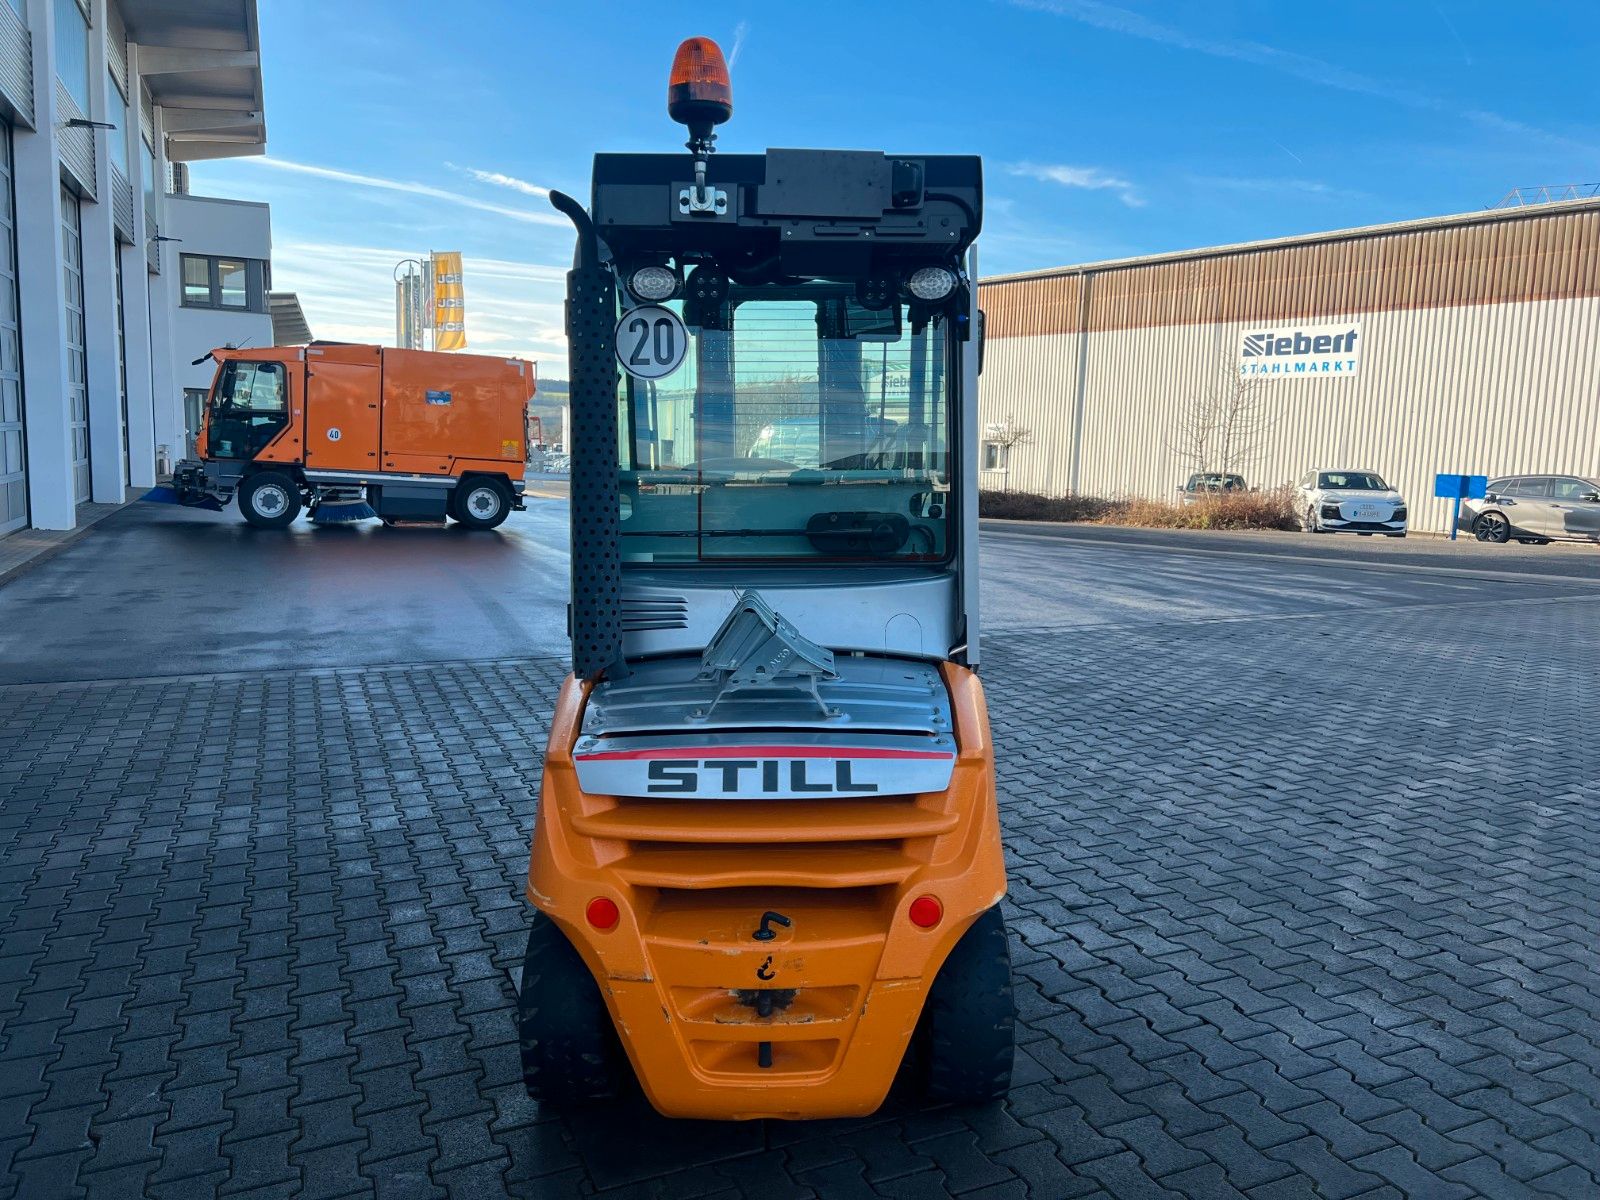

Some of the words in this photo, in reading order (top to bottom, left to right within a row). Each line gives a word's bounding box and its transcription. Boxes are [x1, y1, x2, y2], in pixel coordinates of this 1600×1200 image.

[437, 273, 463, 284] JCB
[437, 298, 464, 308] JCB
[437, 322, 464, 332] JCB
[629, 318, 675, 366] 20
[1242, 329, 1358, 357] Siebert
[1241, 361, 1356, 375] STAHLMARKT
[329, 430, 339, 439] 40
[647, 760, 878, 793] STILL
